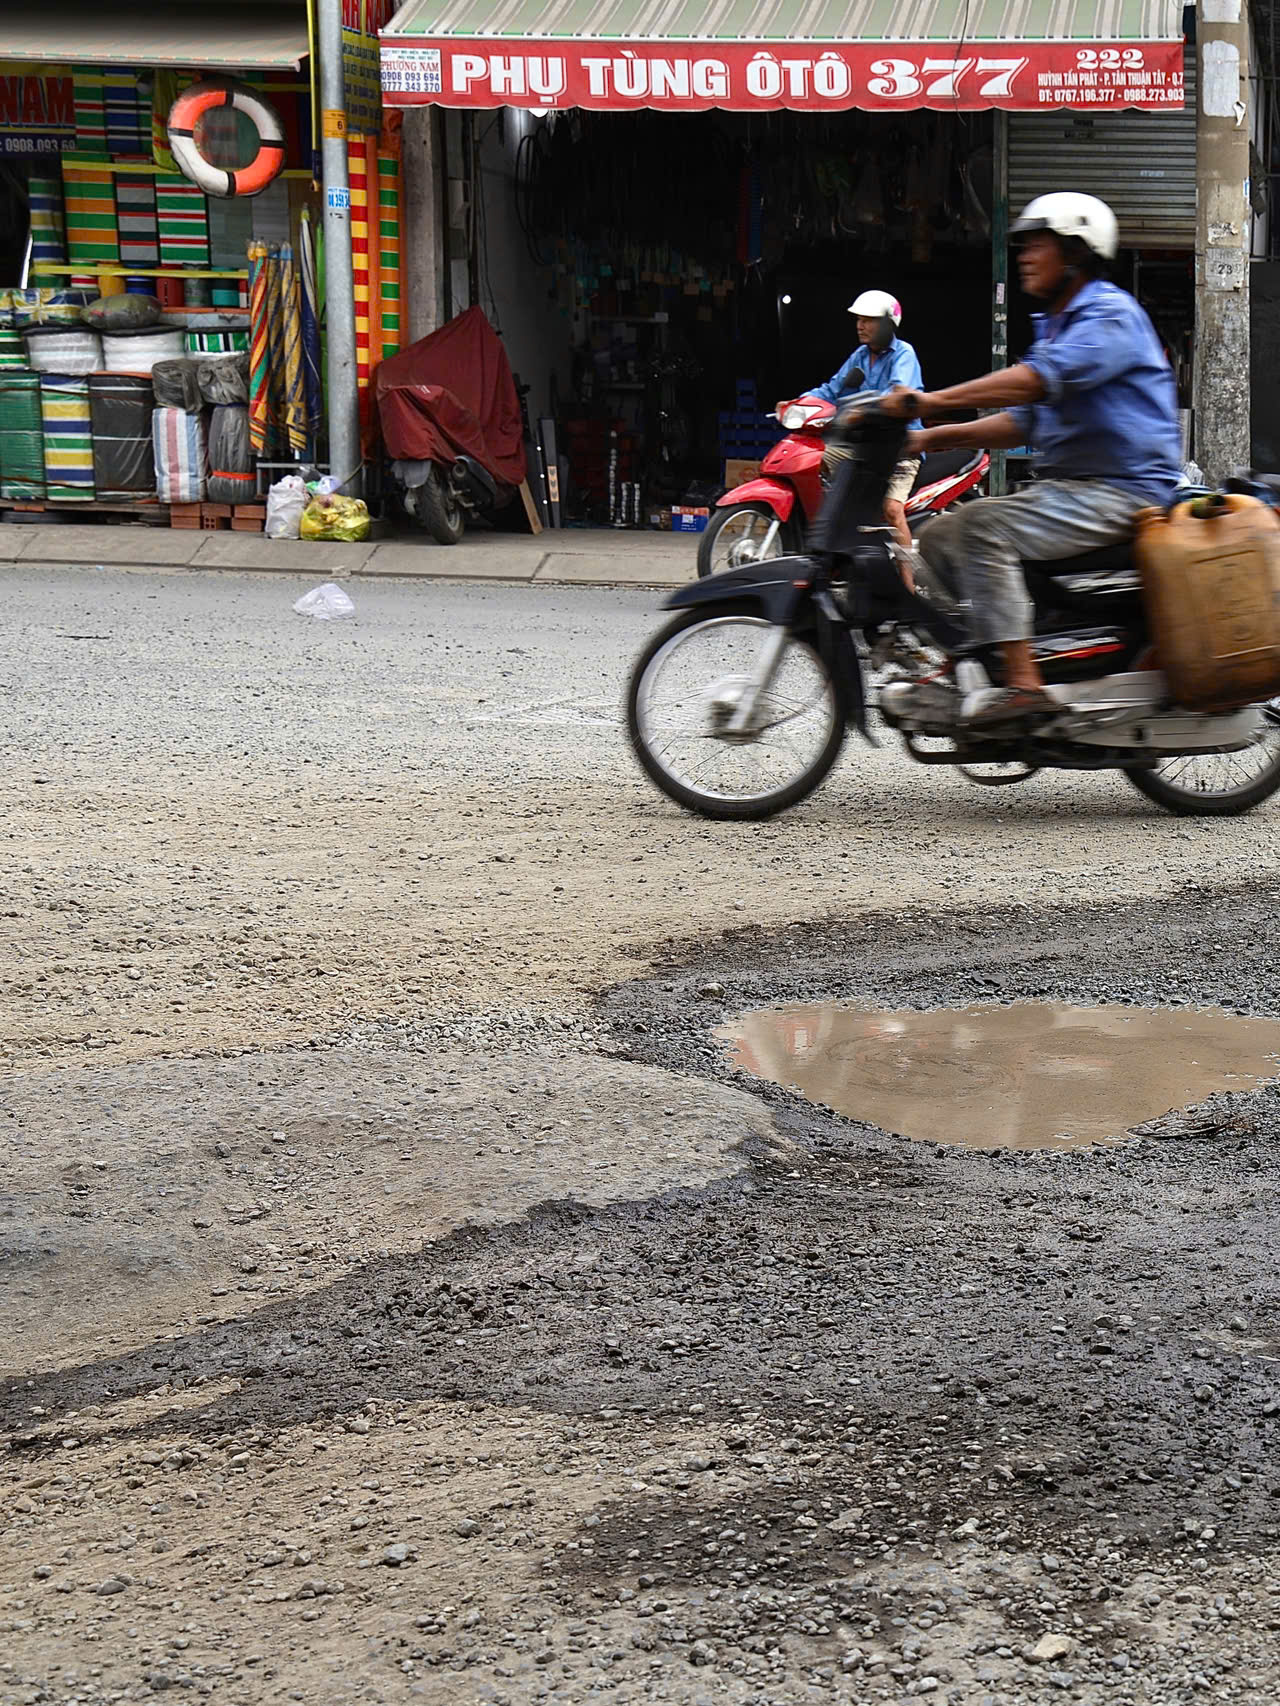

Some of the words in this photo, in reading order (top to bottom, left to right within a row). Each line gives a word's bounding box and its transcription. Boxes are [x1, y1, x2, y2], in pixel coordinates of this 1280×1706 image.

[420, 61, 440, 72] NAM
[1076, 49, 1144, 70] 222
[405, 72, 421, 81] 093
[423, 73, 440, 81] 694
[451, 54, 567, 105] PHỤ
[580, 50, 730, 99] TÙNG
[746, 51, 851, 99] ÔTÔ
[867, 57, 1030, 99] 377
